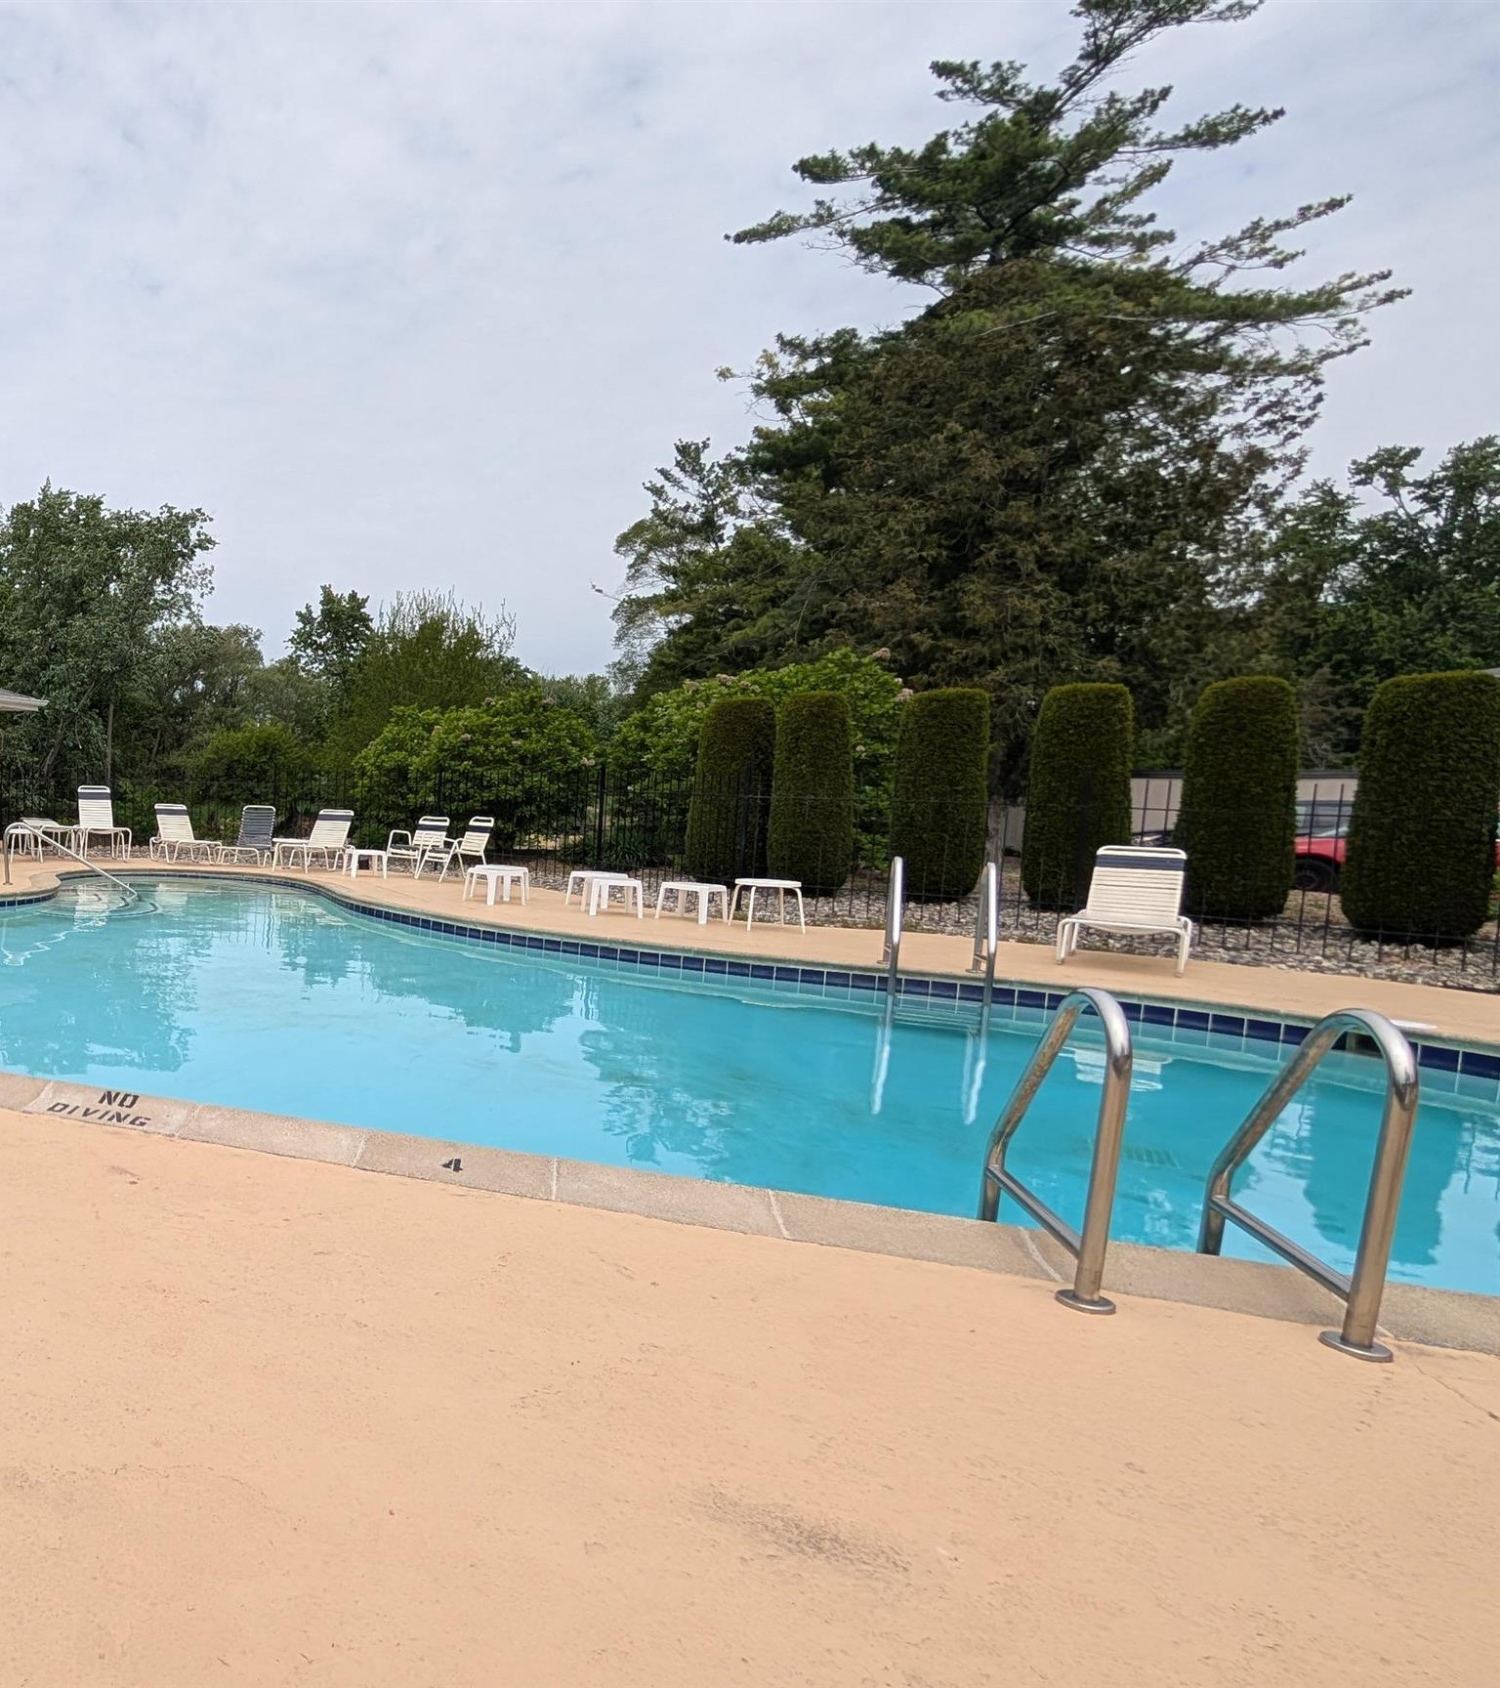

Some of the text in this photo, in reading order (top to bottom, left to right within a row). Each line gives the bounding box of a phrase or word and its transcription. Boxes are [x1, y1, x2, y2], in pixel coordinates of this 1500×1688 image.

[98, 1090, 140, 1108] NO
[46, 1102, 152, 1127] DIVING
[441, 1158, 463, 1172] 4
